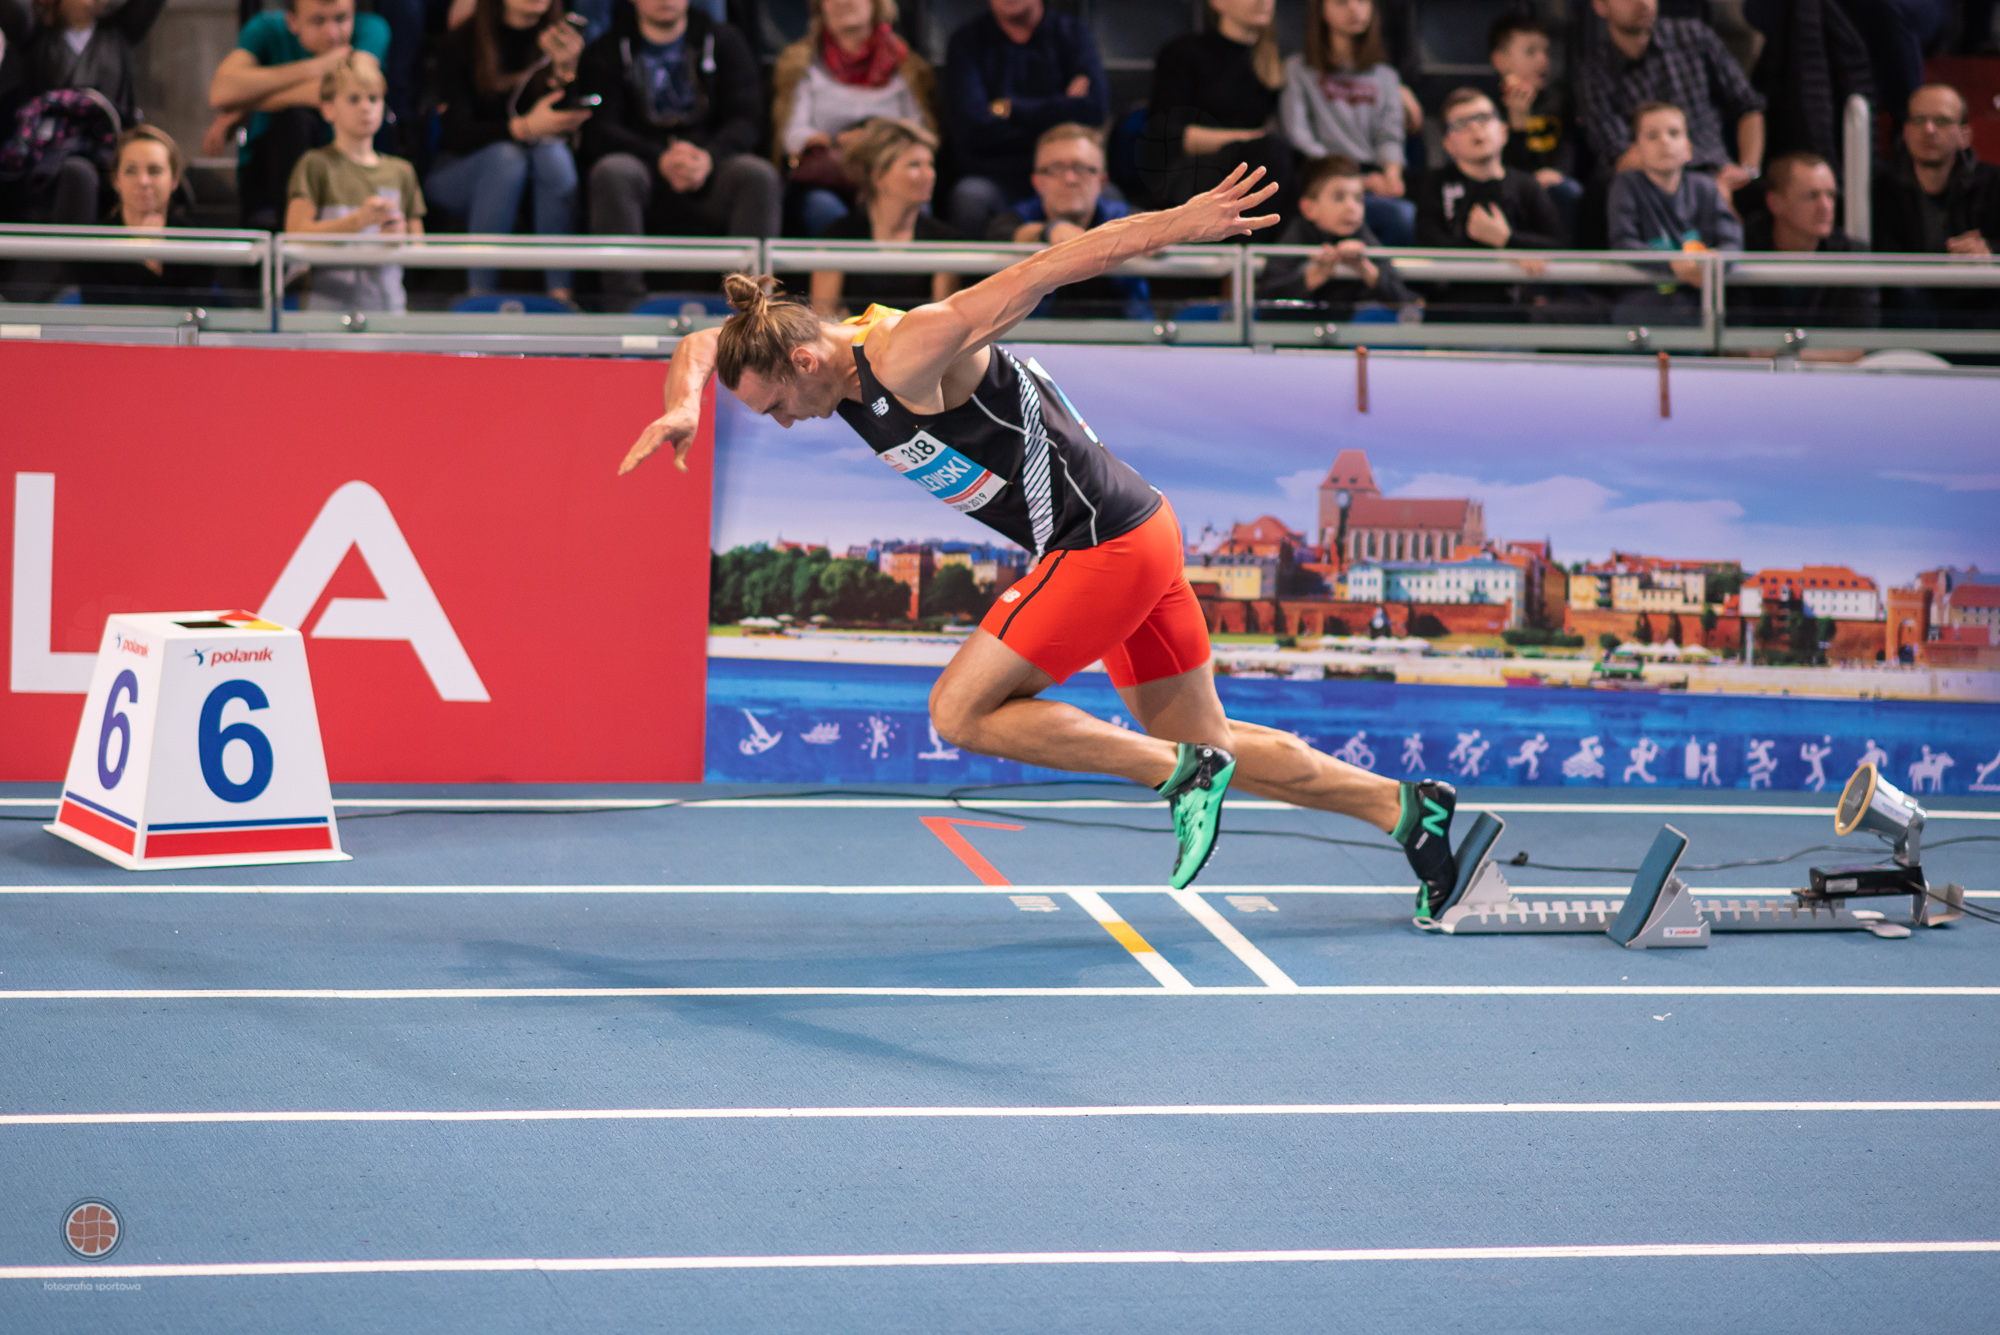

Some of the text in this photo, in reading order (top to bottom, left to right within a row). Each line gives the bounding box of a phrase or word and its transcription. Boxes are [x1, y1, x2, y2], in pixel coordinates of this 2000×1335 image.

[901, 440, 936, 464] 318
[916, 456, 972, 492] LEWSKI
[968, 492, 987, 508] 2019
[210, 646, 273, 668] polanik
[97, 669, 138, 791] 6
[198, 679, 274, 803] 6
